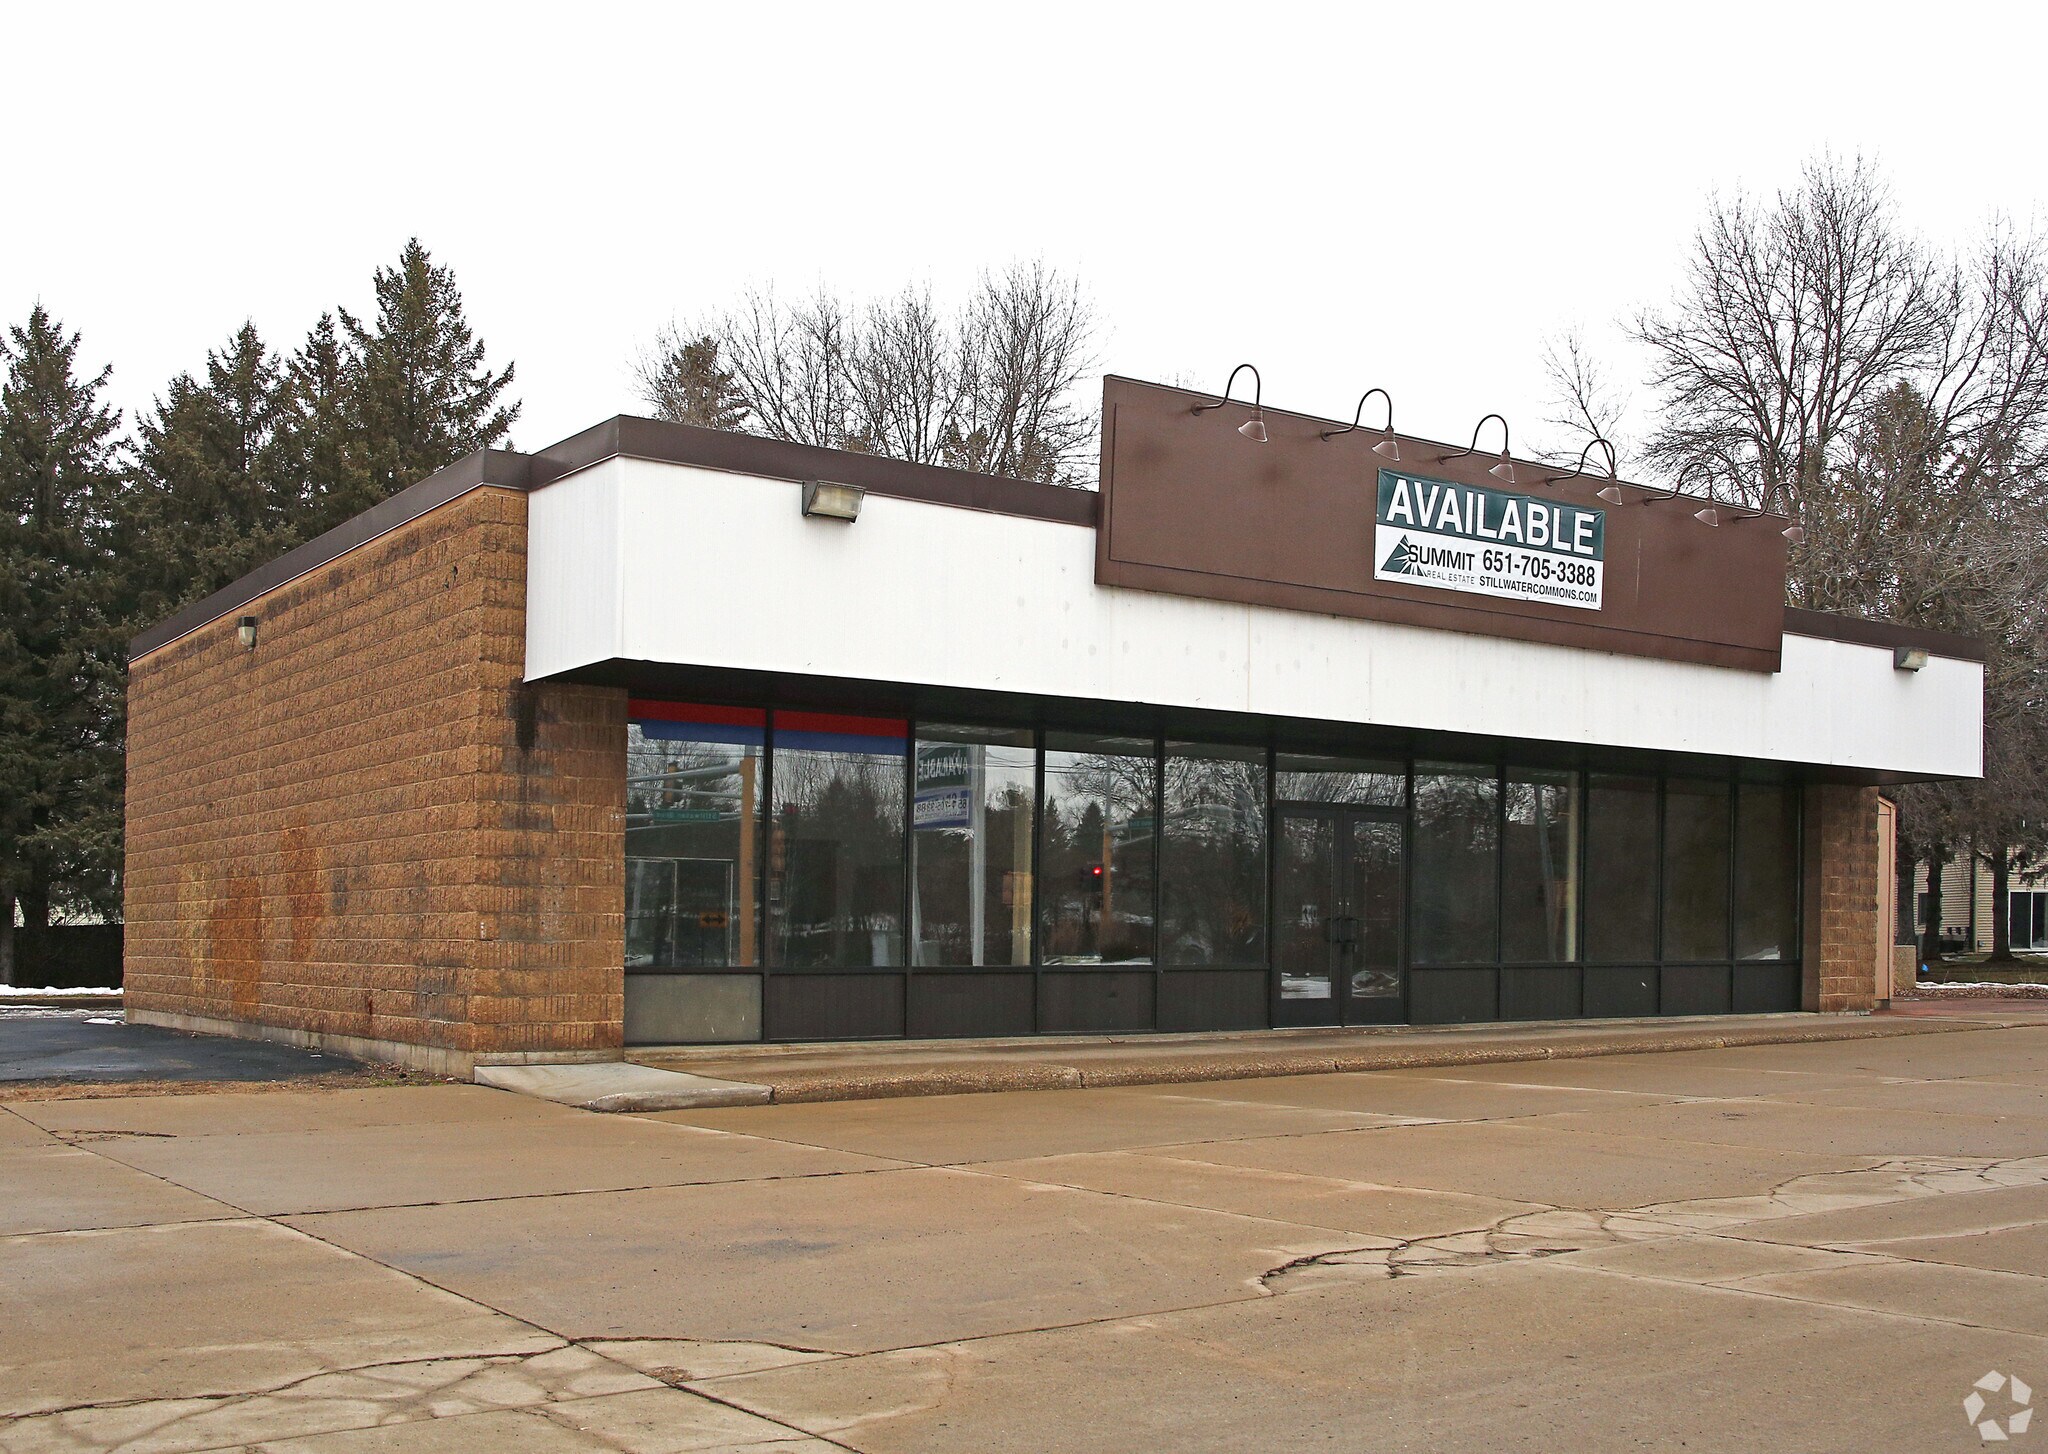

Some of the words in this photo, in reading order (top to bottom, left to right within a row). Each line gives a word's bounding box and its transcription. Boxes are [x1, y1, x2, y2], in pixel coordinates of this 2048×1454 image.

[1386, 478, 1595, 555] AVAILABLE
[1408, 544, 1475, 571] SUMMIT
[1483, 549, 1595, 587] 651-705-3388
[1427, 569, 1446, 581] REAL
[1448, 573, 1475, 585] ESTATE
[1479, 575, 1597, 603] STILLWATERCOMMONS.COM
